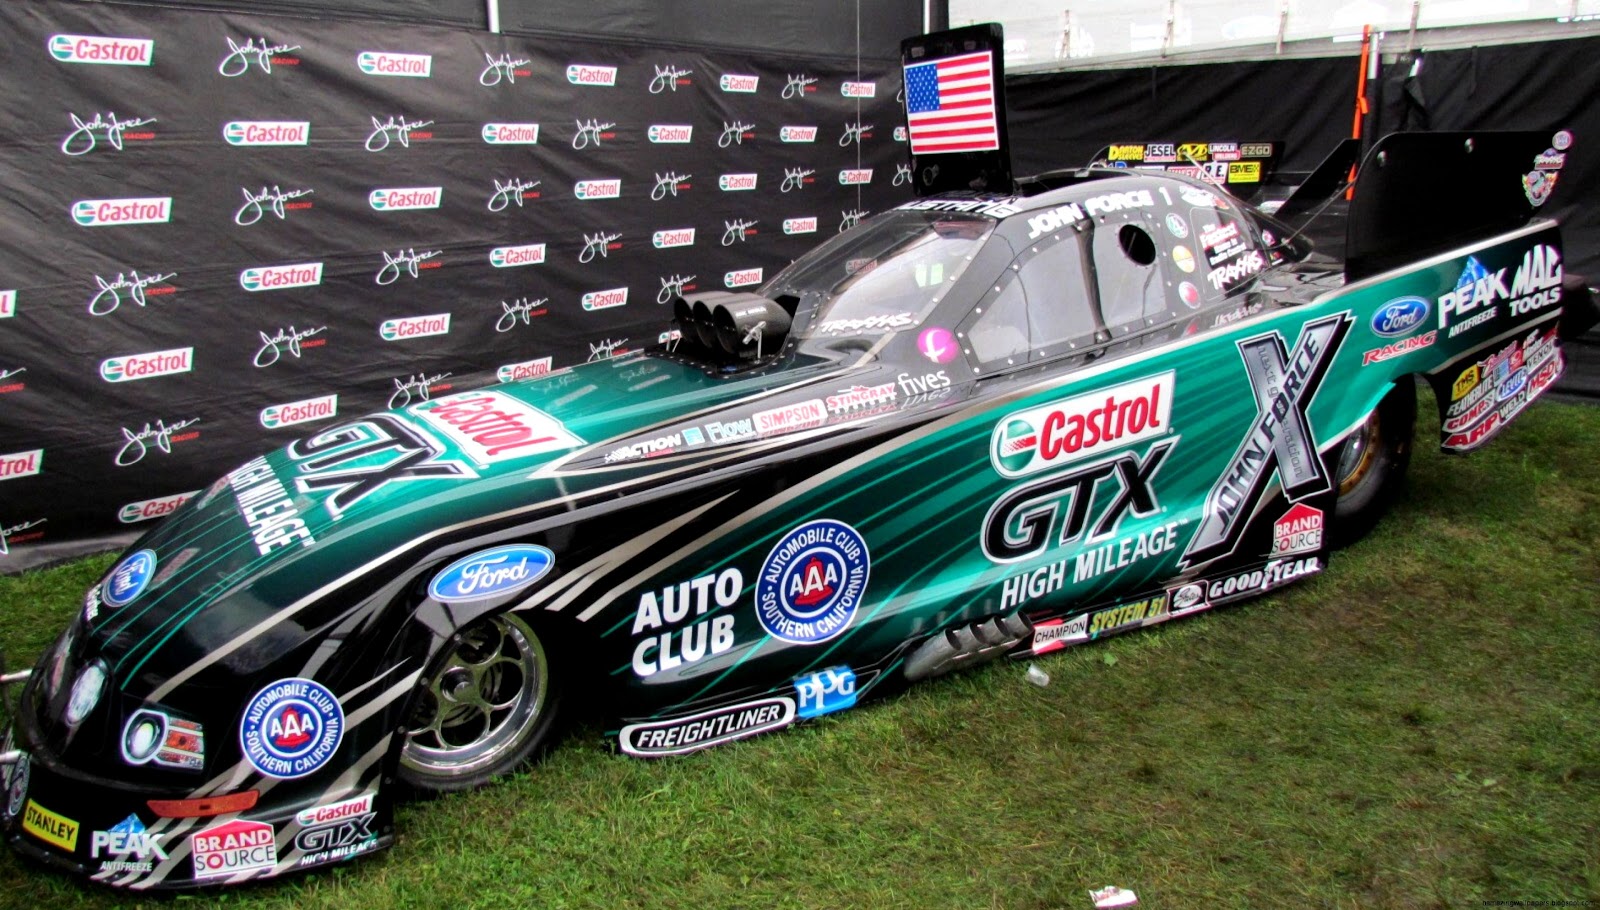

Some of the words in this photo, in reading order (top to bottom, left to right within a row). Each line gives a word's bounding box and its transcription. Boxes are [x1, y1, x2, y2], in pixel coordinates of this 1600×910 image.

[76, 38, 145, 62] Castrol
[377, 55, 425, 73] Castrol
[580, 67, 613, 82] Castrol
[731, 78, 756, 89] Castrol
[850, 85, 873, 95] Castrol
[123, 132, 155, 140] RACING
[246, 124, 303, 143] Castrol
[498, 126, 535, 141] Castrol
[659, 128, 689, 140] Castrol
[789, 129, 815, 140] Castrol
[1145, 145, 1175, 157] JESEL
[1241, 146, 1270, 155] EZGO
[587, 183, 617, 196] Castrol
[729, 176, 754, 188] Castrol
[848, 171, 872, 183] Castrol
[388, 191, 436, 208] Castrol
[96, 202, 164, 223] Castrol
[1028, 203, 1085, 240] JOHN
[1085, 190, 1154, 216] FORCE
[1159, 187, 1173, 206] 1
[664, 232, 692, 245] Castrol
[792, 220, 815, 232] Castrol
[419, 261, 442, 269] RACING
[504, 248, 542, 265] Castrol
[261, 268, 317, 288] Castrol
[734, 271, 761, 285] Castrol
[1510, 244, 1563, 300] MAC
[145, 286, 176, 296] RACING
[594, 291, 625, 308] Castrol
[1438, 268, 1511, 330] PEAK
[1510, 287, 1561, 317] TOOLS
[398, 319, 445, 337] Castrol
[1382, 304, 1419, 332] Ford
[1448, 306, 1498, 339] ANTIFREEZE
[301, 338, 326, 348] RACING
[1362, 330, 1438, 367] RACING
[124, 353, 187, 378] Castrol
[512, 362, 551, 379] Castrol
[897, 370, 951, 396] fives
[1456, 370, 1476, 390] TMS
[826, 383, 895, 408] STINGRAY
[1500, 391, 1525, 418] WELD
[280, 399, 332, 424] Castrol
[760, 404, 821, 429] SIMPSON
[1039, 383, 1161, 461] Castrol
[1447, 400, 1487, 430] COMP
[171, 432, 200, 443] RACING
[429, 396, 558, 457] Castrol
[1213, 439, 1266, 536] JOHN
[1260, 333, 1320, 443] FORCE
[1445, 412, 1499, 447] ARP
[0, 453, 36, 478] trol
[287, 411, 481, 520] GTX
[142, 498, 188, 518] Cast
[980, 434, 1183, 565] GTX
[236, 478, 312, 556] MILEAGE
[1275, 515, 1321, 537] BRAND
[1273, 530, 1321, 551] SOURCE
[765, 527, 836, 584] AUTOMOBILE
[835, 531, 861, 560] CLUB
[1000, 559, 1067, 611] HIGH
[1072, 521, 1179, 585] MILEAGE
[114, 558, 147, 596] Ford
[457, 555, 531, 594] Ford
[789, 562, 838, 597] AAA
[1209, 556, 1322, 599] GOODYEAR
[631, 567, 743, 636] AUTO
[762, 592, 816, 638] SOUTHERN
[816, 564, 864, 634] CALIFORNIA
[1090, 600, 1146, 633] SYSTEM
[1148, 597, 1166, 618] 51
[631, 614, 736, 677] CLUB
[1034, 622, 1086, 644] CHAMPION
[797, 670, 856, 710] PPG
[248, 683, 309, 725] AUTOMOBILE
[309, 688, 334, 714] CLUB
[270, 713, 315, 739] AAA
[637, 705, 781, 748] FREIGHTLINER
[246, 730, 293, 773] SOUTHERN
[295, 717, 339, 771] CALIFORNIA
[316, 798, 368, 822] Castrol
[26, 804, 76, 842] STANLEY
[295, 811, 378, 852] GTX
[91, 830, 170, 860] PEAK
[196, 829, 273, 853] BRAND
[100, 860, 153, 872] ANTIFREEZE
[196, 845, 275, 871] SOURCE
